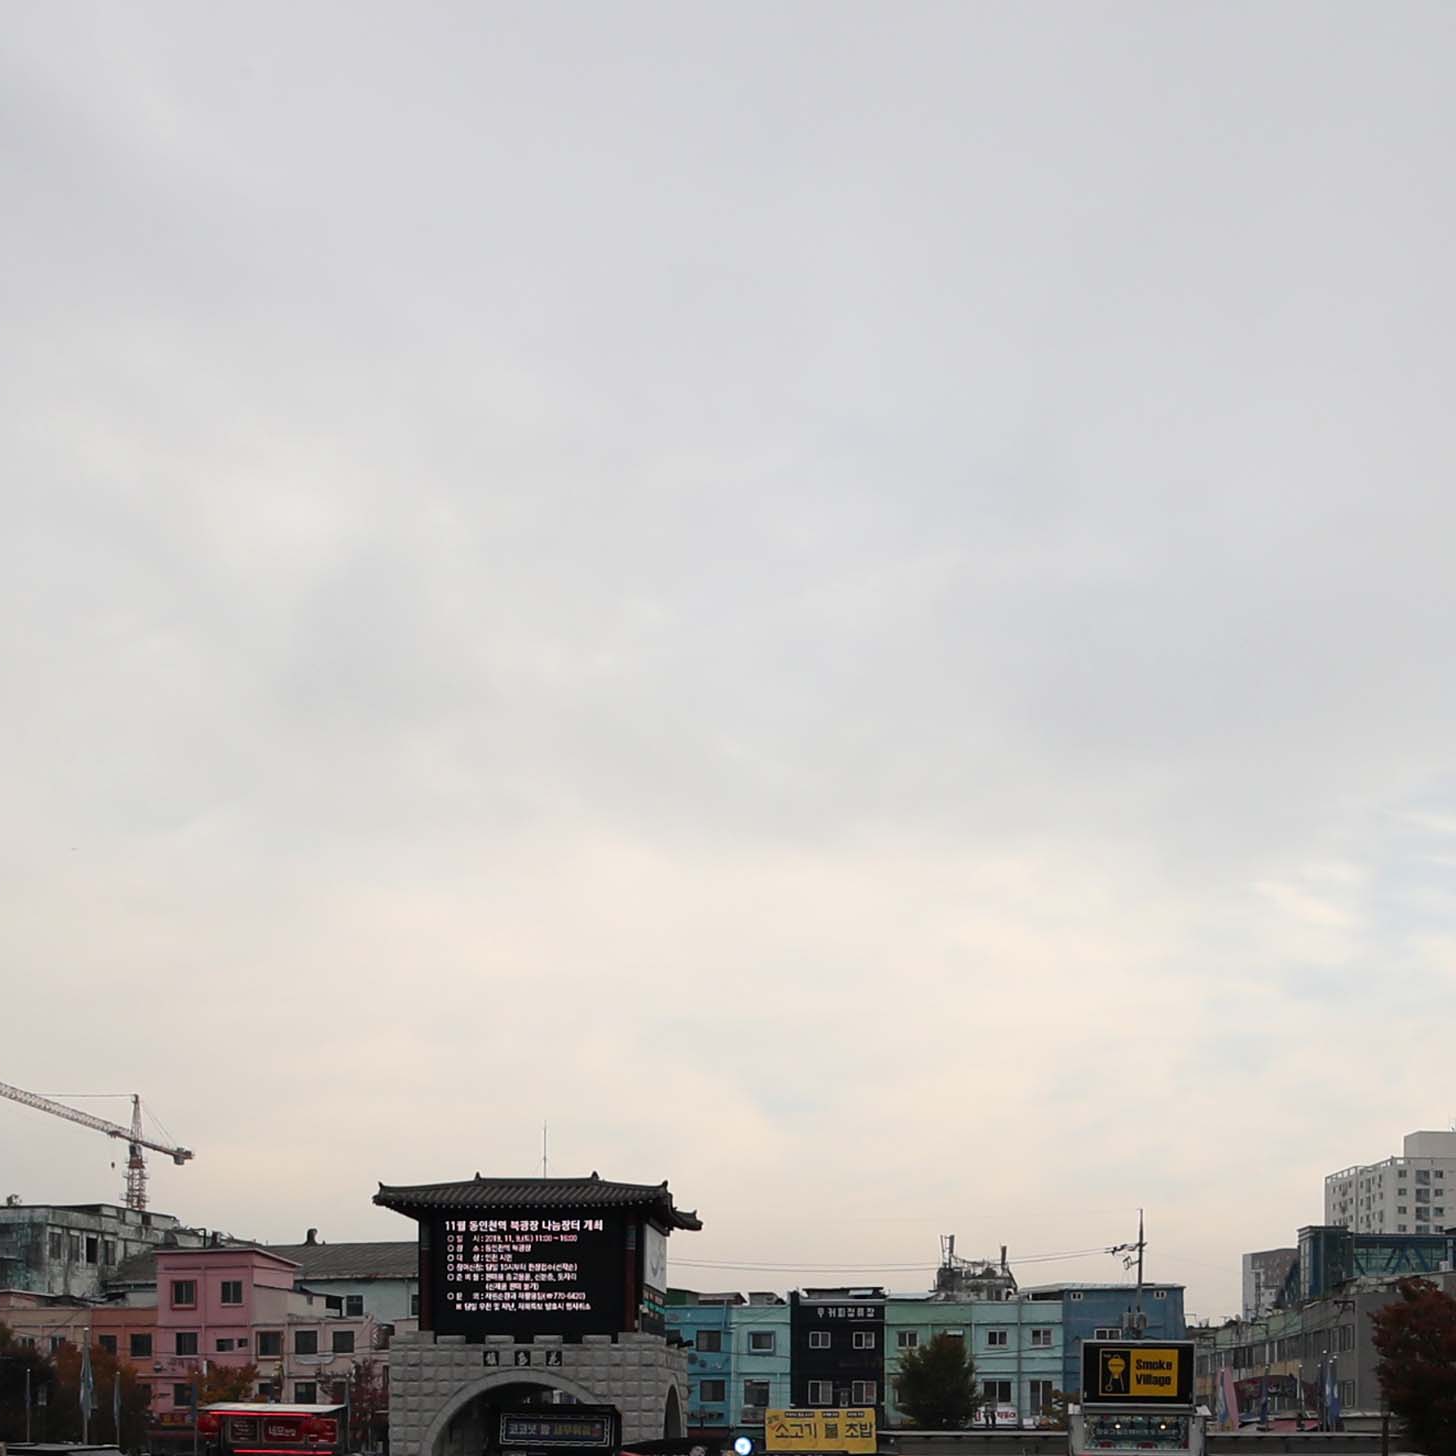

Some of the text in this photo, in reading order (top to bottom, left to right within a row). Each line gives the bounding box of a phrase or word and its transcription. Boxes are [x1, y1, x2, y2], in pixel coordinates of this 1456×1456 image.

[445, 1220, 603, 1232] 11월 동인천역 북광장 나눔장터 개최
[1135, 1358, 1173, 1371] Smoke
[1135, 1373, 1173, 1387] Village
[774, 1422, 818, 1439] 소고기
[844, 1422, 874, 1439] 초밥
